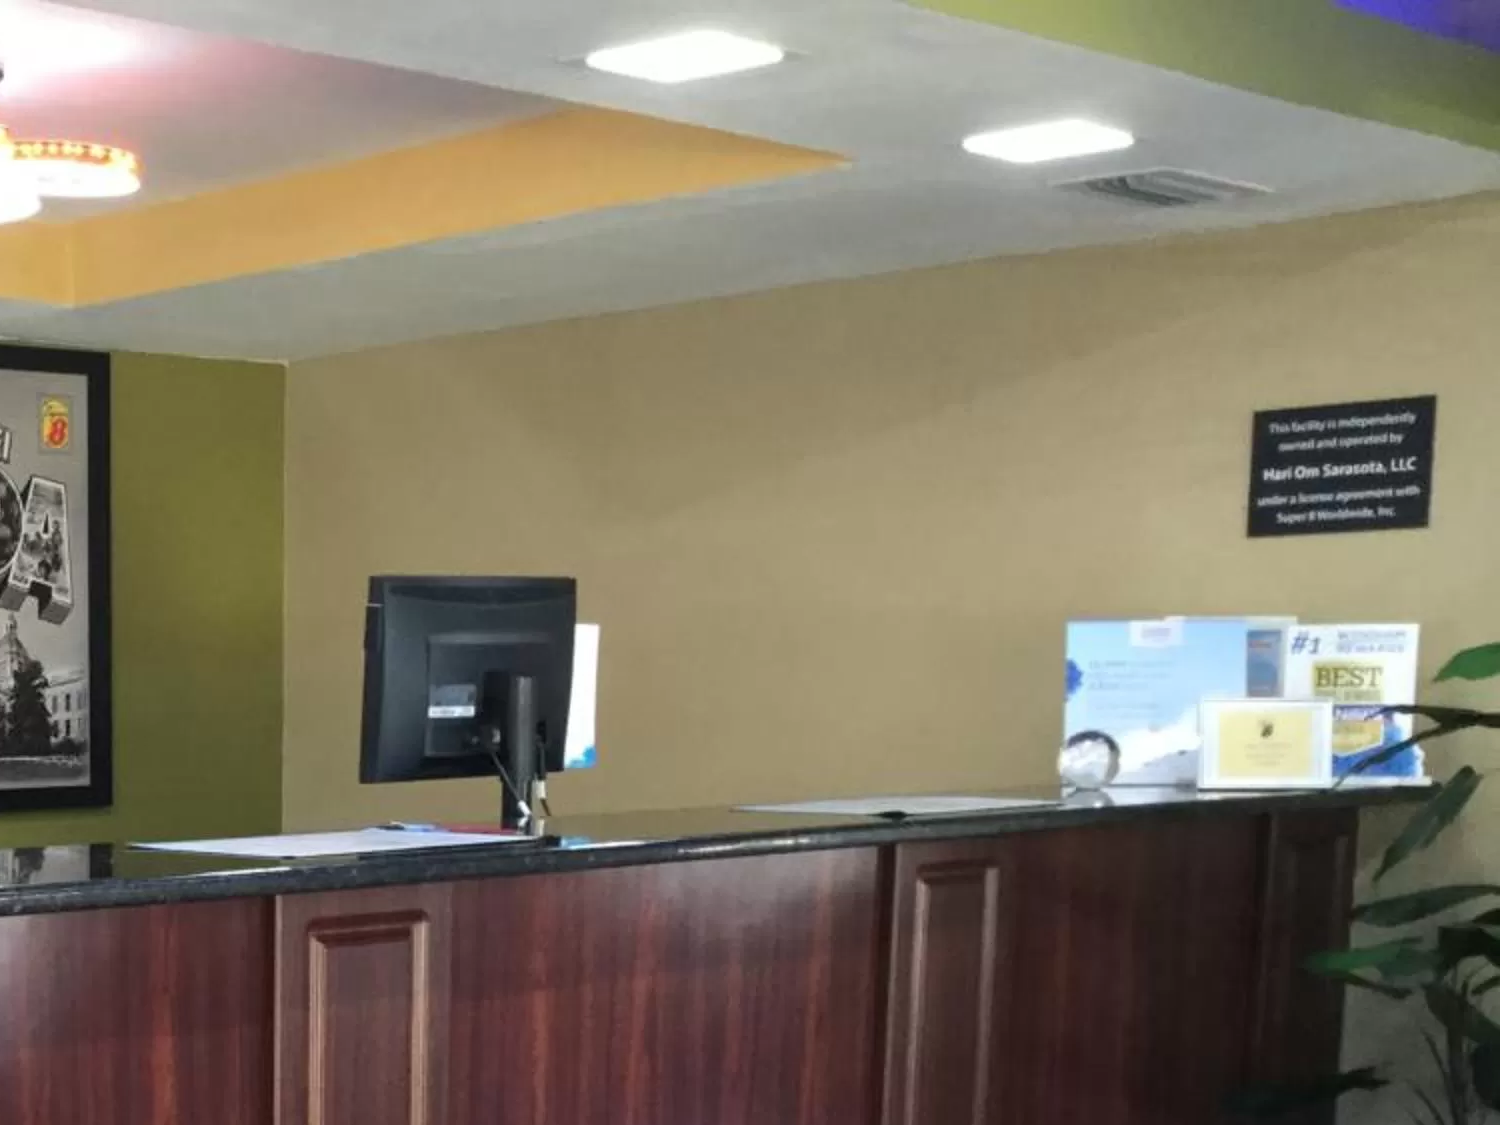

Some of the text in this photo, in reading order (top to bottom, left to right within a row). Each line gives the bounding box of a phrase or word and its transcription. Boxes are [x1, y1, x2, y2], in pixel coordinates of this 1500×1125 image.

[1389, 432, 1404, 445] by
[1294, 465, 1320, 480] Om
[1322, 460, 1387, 478] Sarasota,
[1390, 456, 1418, 472] LLC
[1291, 631, 1321, 655] #1
[1314, 665, 1384, 688] BEST
